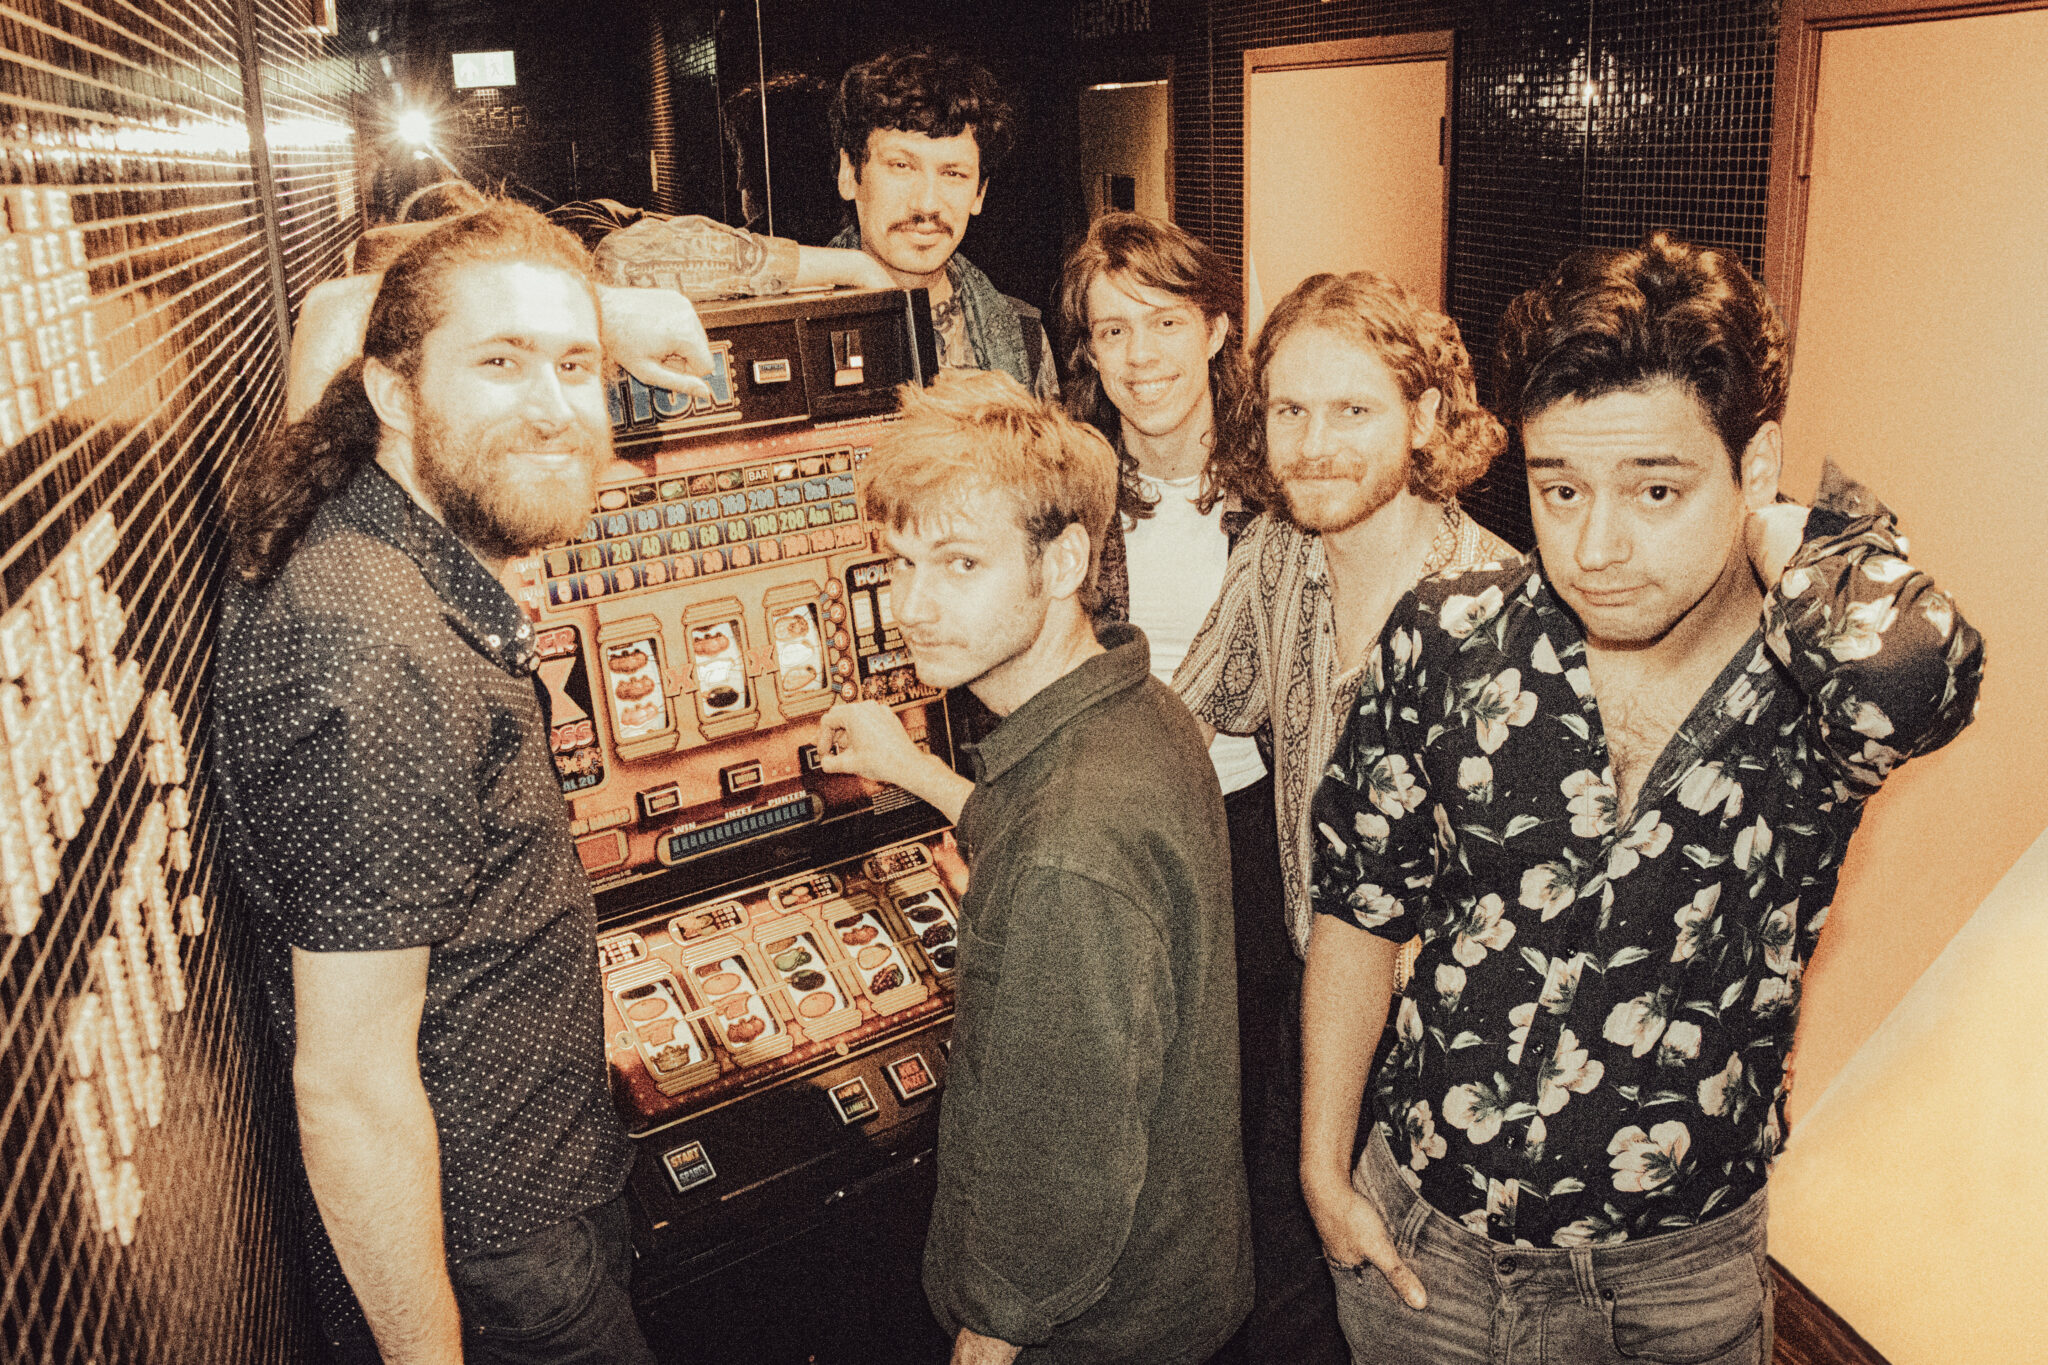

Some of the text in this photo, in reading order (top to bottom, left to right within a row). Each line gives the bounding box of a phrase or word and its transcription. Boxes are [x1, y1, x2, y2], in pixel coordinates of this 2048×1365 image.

[748, 469, 769, 483] BAR
[693, 497, 719, 522] 120
[611, 541, 632, 565] 20
[641, 535, 662, 559] 40
[670, 530, 691, 554] 40
[753, 514, 778, 537] 100
[780, 509, 806, 532] 200
[844, 685, 853, 697] 5
[579, 775, 596, 788] 20
[673, 790, 807, 835] WIN INZET PUNTEN
[836, 1082, 861, 1100] INFO
[669, 1147, 700, 1168] START
